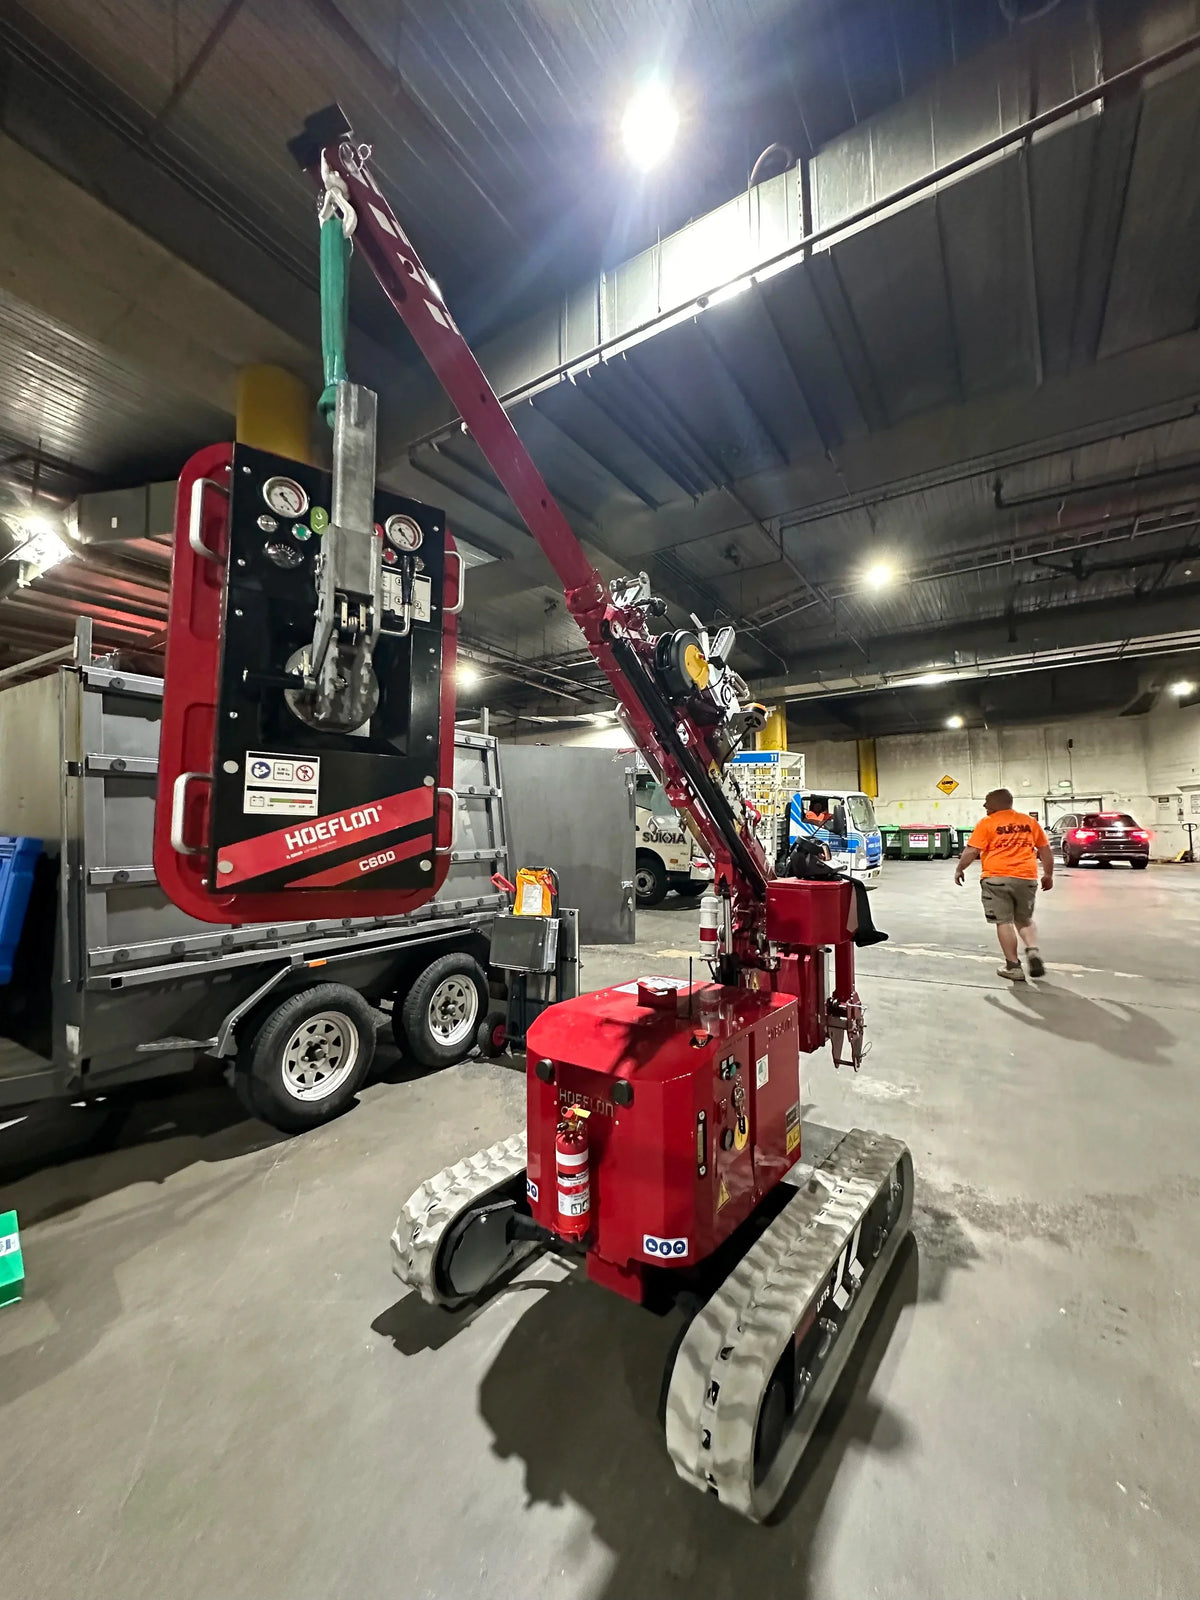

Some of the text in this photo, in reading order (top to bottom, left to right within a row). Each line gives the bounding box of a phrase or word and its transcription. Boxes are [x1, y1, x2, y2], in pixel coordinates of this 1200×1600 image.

[770, 753, 778, 762] 11
[285, 807, 380, 850] HOEFLON
[359, 850, 396, 872] C600
